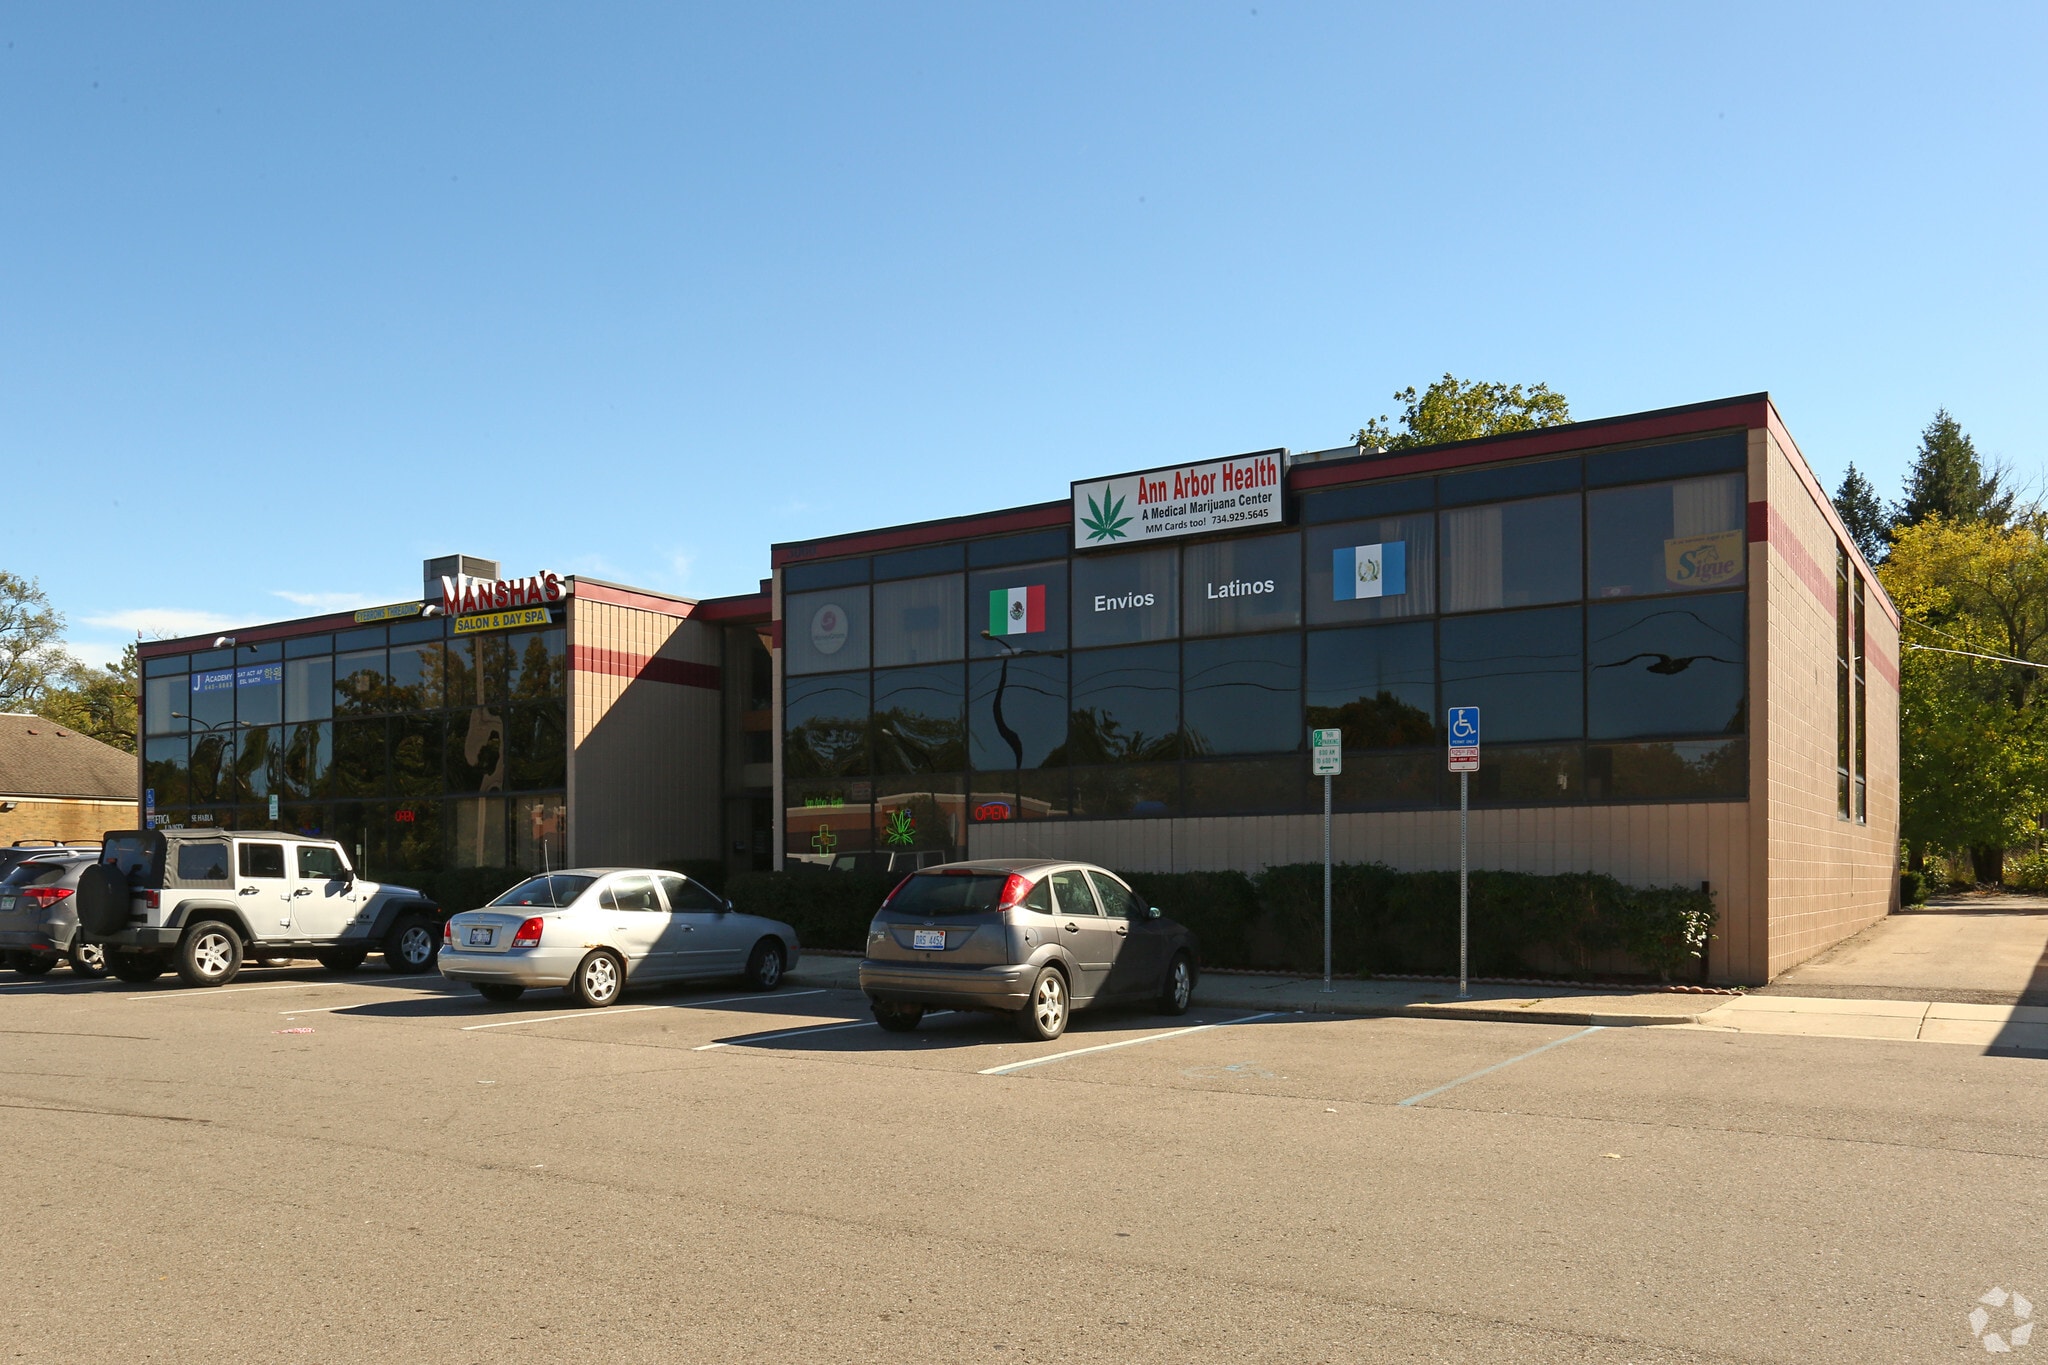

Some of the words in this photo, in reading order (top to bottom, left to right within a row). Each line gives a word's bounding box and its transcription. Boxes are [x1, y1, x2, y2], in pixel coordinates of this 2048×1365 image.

[1137, 476, 1167, 505] Ann
[1173, 469, 1216, 500] Arbor
[1222, 457, 1277, 492] Health
[1142, 509, 1149, 521] A
[1151, 503, 1187, 519] Medical
[1190, 498, 1236, 514] Marijuana
[1238, 493, 1272, 506] Center
[1145, 524, 1163, 534] MM
[1165, 521, 1188, 531] Cards
[1190, 518, 1206, 527] too!
[1211, 508, 1269, 525] 734.929.5645
[1676, 550, 1734, 582] Sigue
[442, 570, 562, 615] MANSHA'S
[1094, 592, 1155, 612] Envios
[1207, 577, 1275, 600] Latinos
[457, 617, 490, 631] SALON
[493, 616, 500, 627] &
[503, 613, 522, 625] DAY
[525, 611, 544, 623] SPA
[395, 809, 415, 822] OPEN
[975, 804, 1009, 821] OPEN
